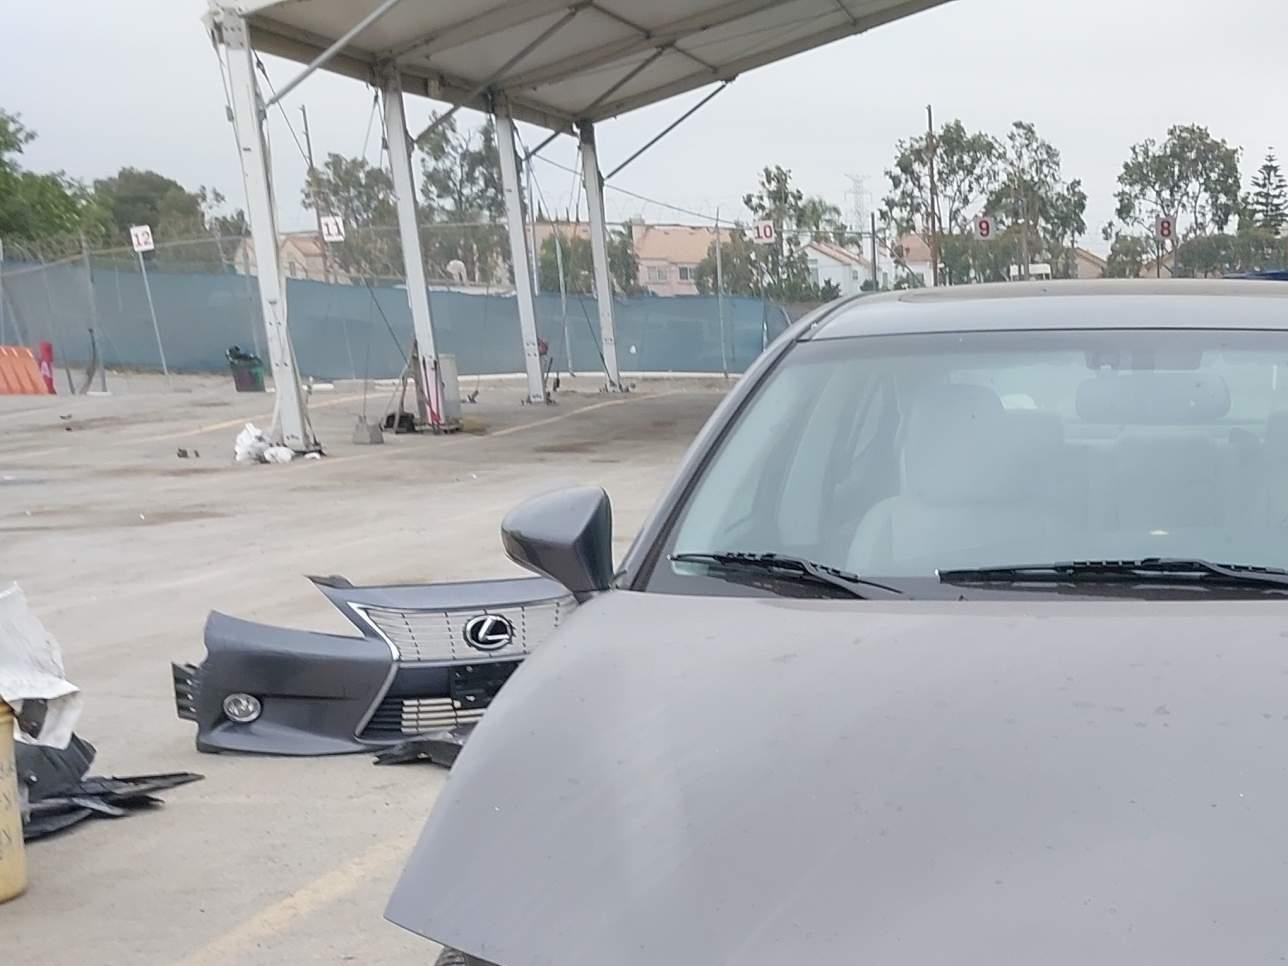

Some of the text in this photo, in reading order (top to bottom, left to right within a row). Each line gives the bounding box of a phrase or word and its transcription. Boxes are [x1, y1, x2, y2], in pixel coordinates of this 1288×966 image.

[324, 221, 342, 237] 11
[754, 224, 773, 240] 10
[979, 220, 990, 237] 9
[1160, 220, 1171, 237] 8
[134, 231, 152, 246] 12
